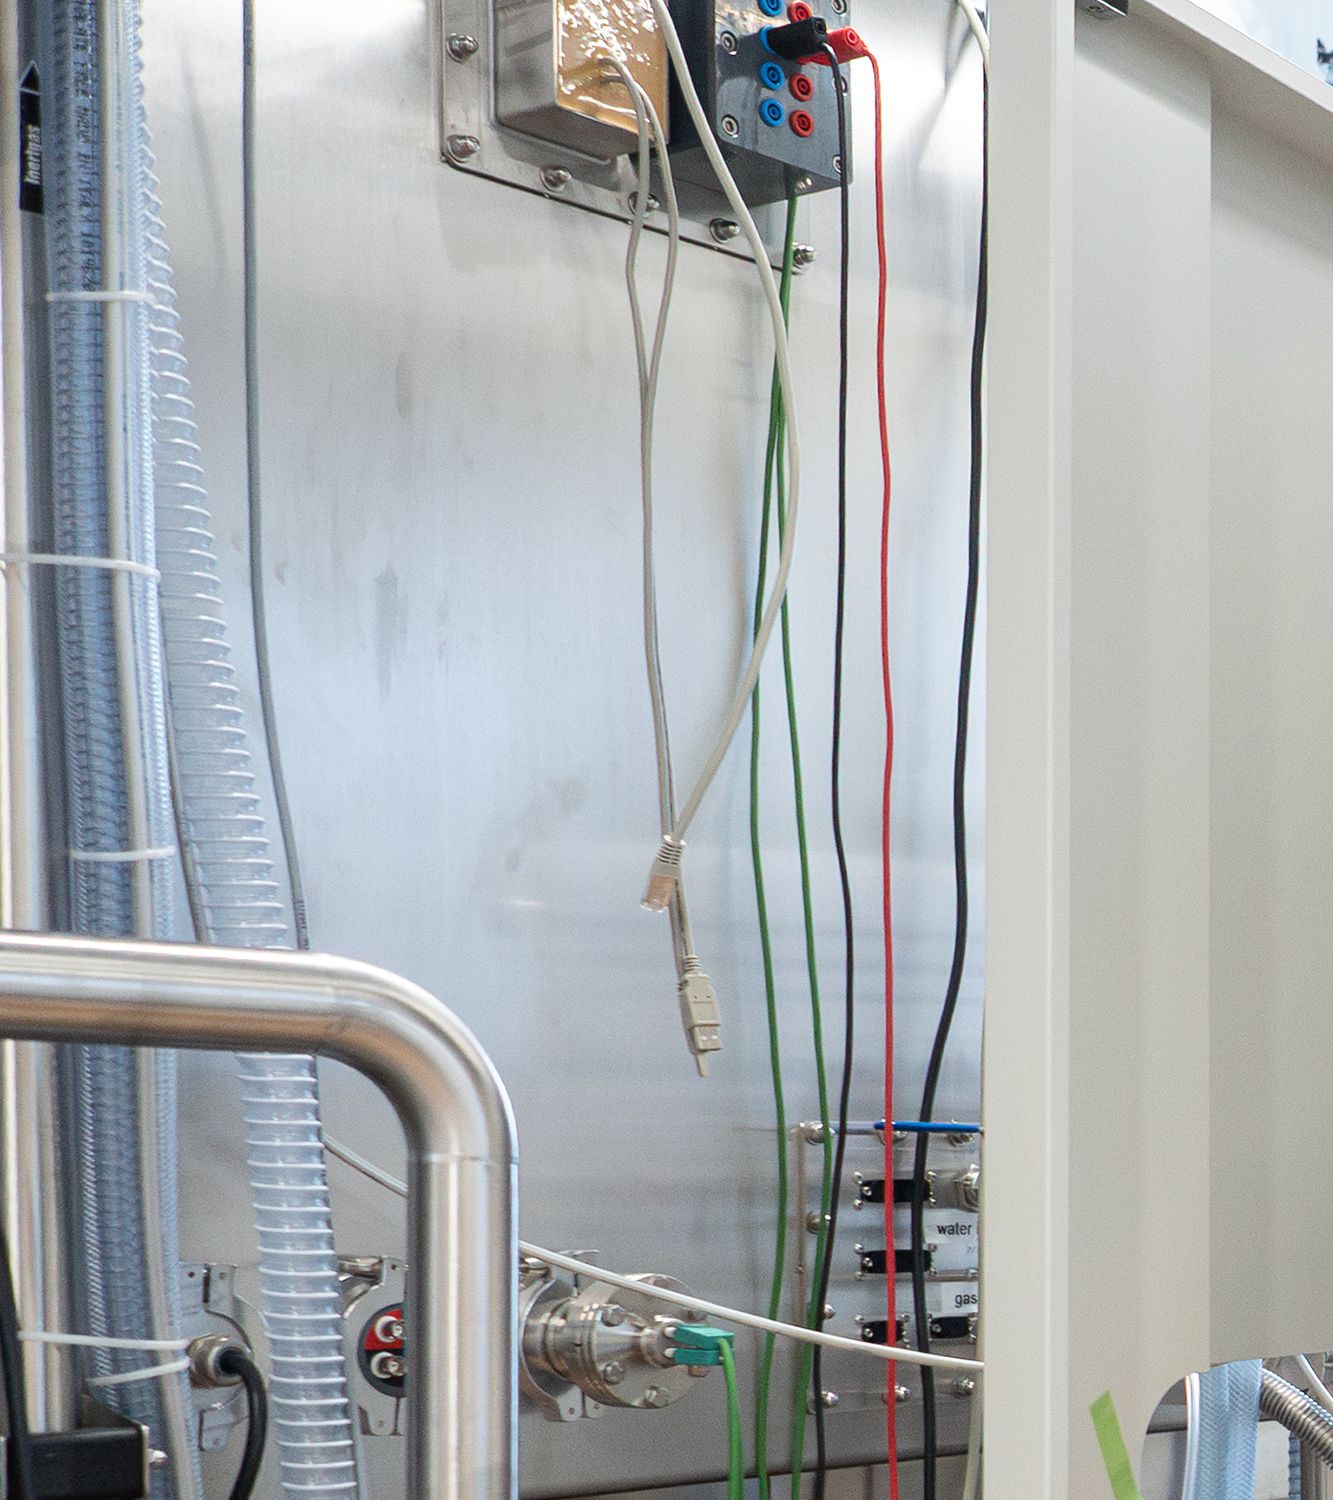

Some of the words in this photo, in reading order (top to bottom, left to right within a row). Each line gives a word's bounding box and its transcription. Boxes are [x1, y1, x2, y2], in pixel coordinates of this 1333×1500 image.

[24, 124, 41, 185] Inertgas
[936, 1222, 973, 1235] water
[954, 1294, 978, 1308] gas
